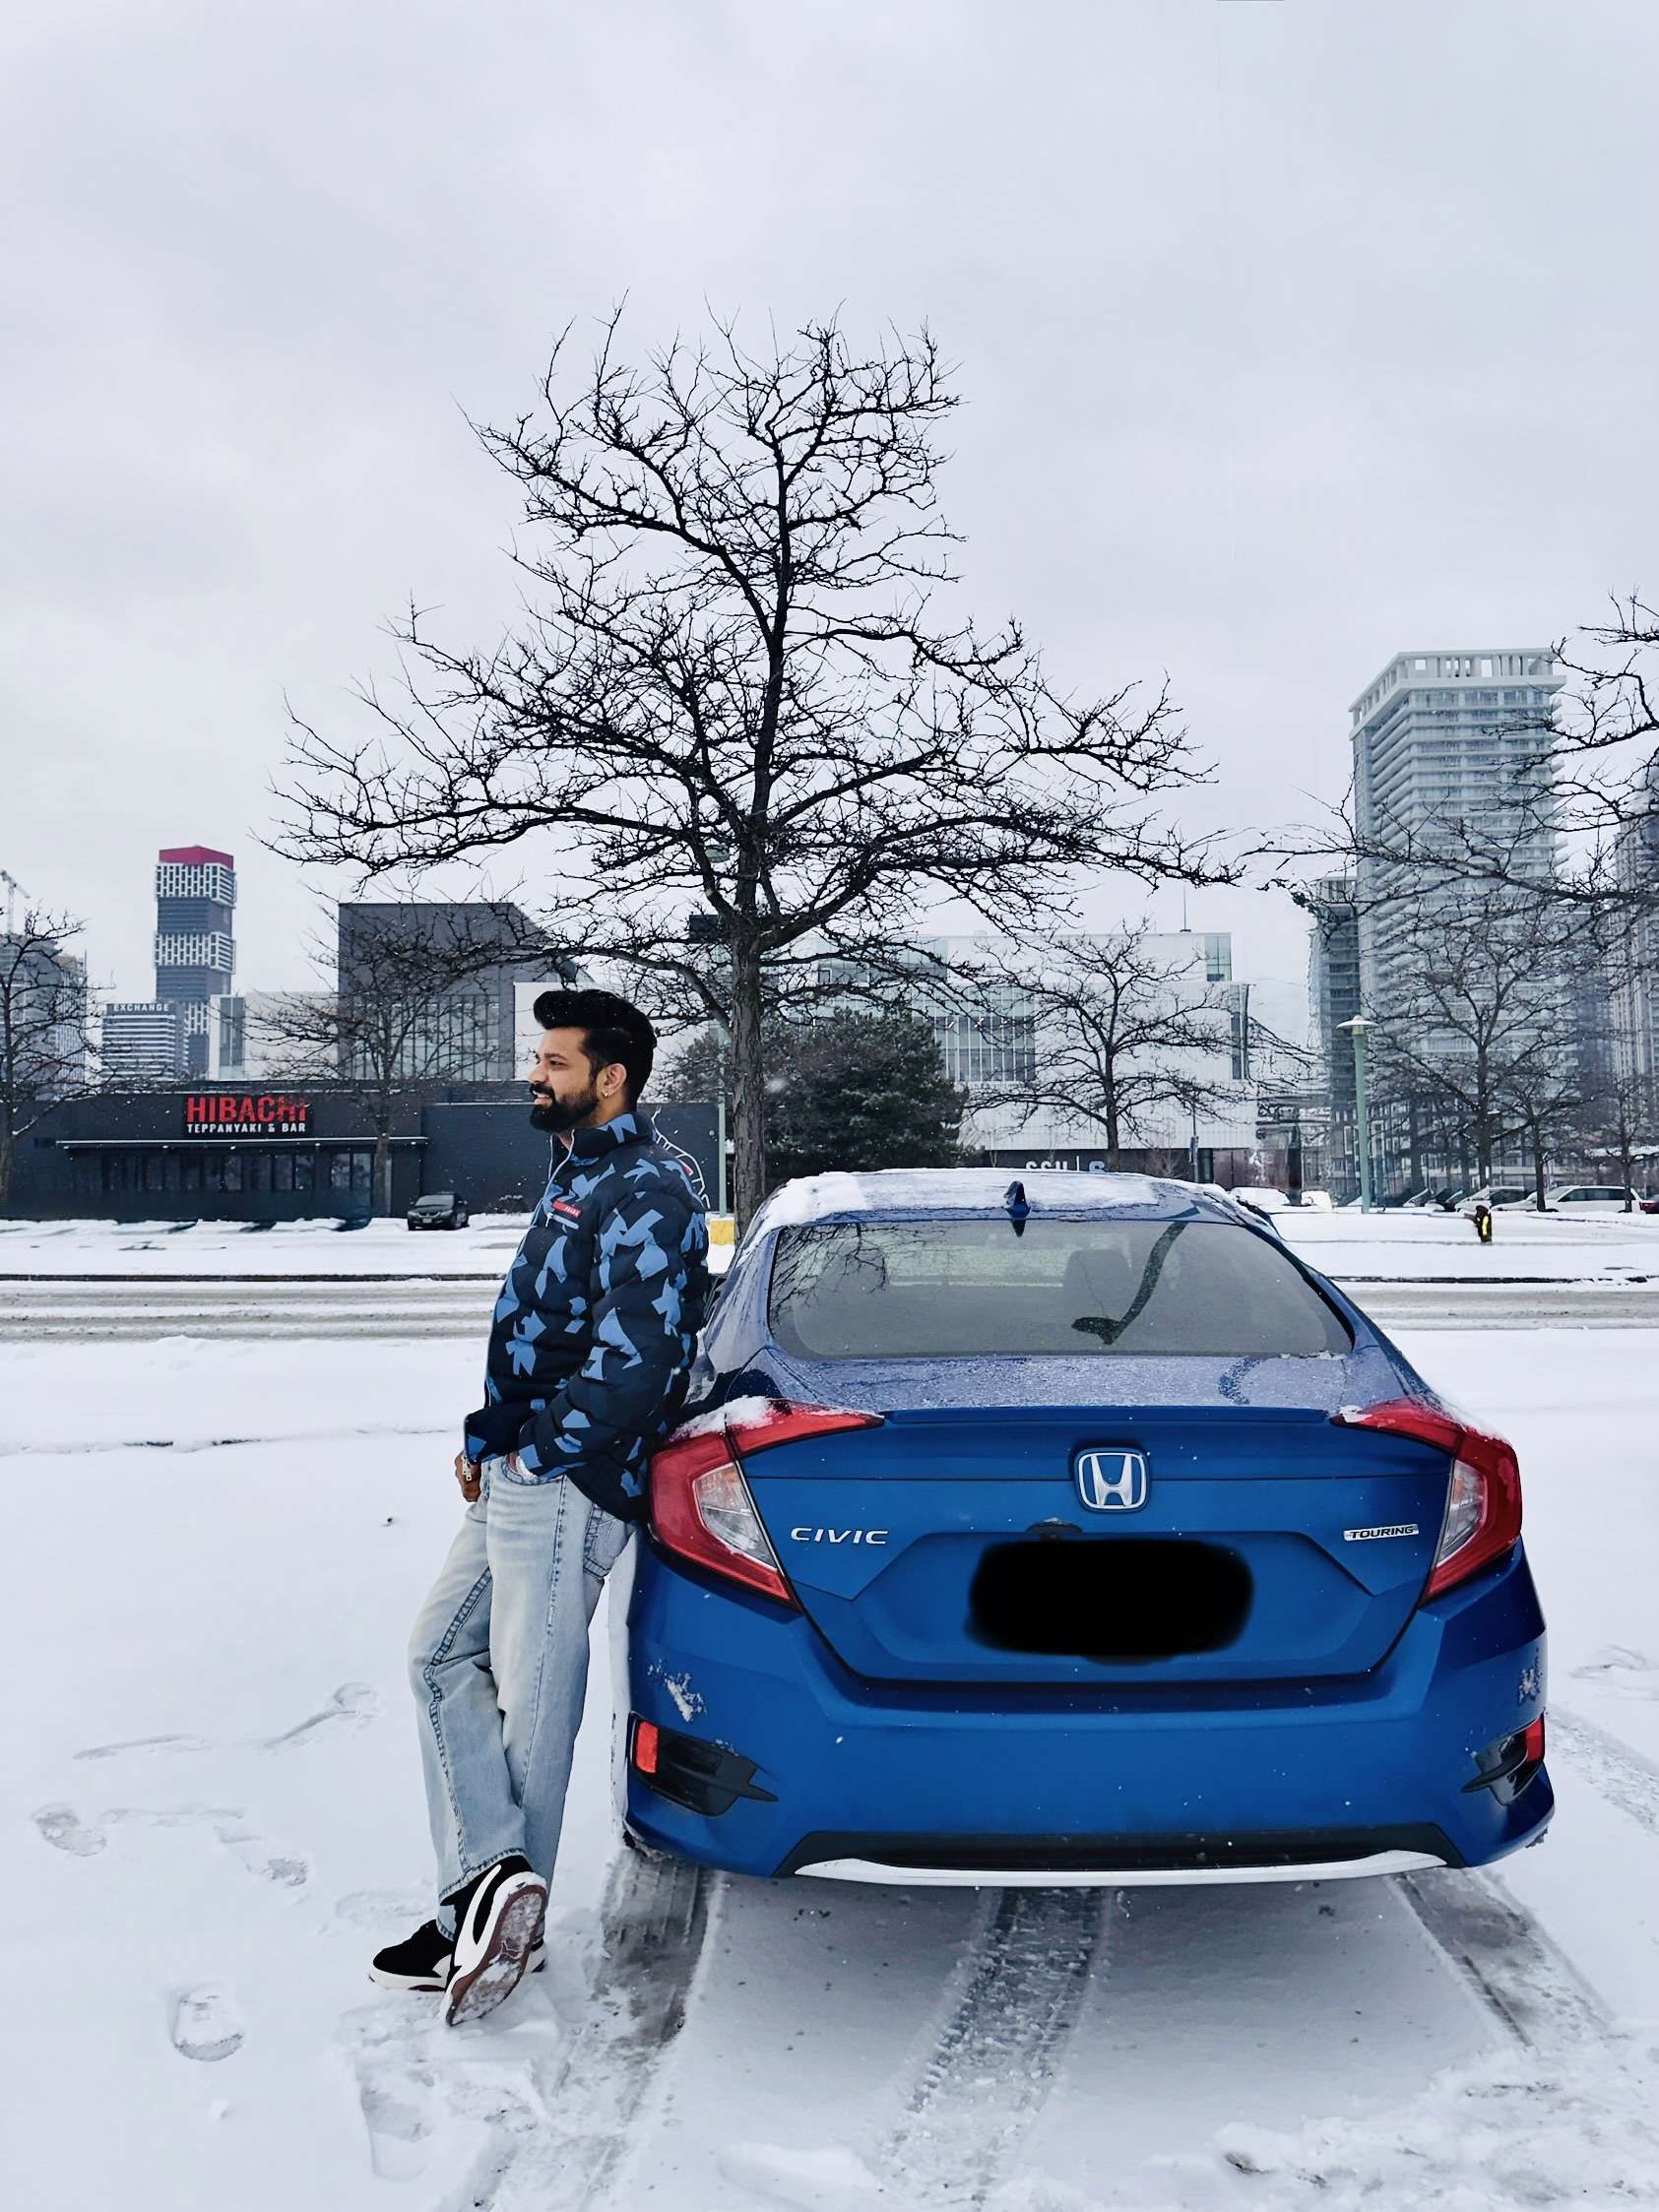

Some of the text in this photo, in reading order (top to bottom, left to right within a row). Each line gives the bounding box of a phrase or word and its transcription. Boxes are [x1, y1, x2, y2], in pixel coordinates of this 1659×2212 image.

[113, 1003, 169, 1012] EXCHANGE
[186, 1096, 307, 1122] HIBACHI
[187, 1122, 306, 1133] TEPPANYAKI & BAR
[790, 1527, 889, 1545] CIVIC
[1350, 1525, 1414, 1539] TOURING
